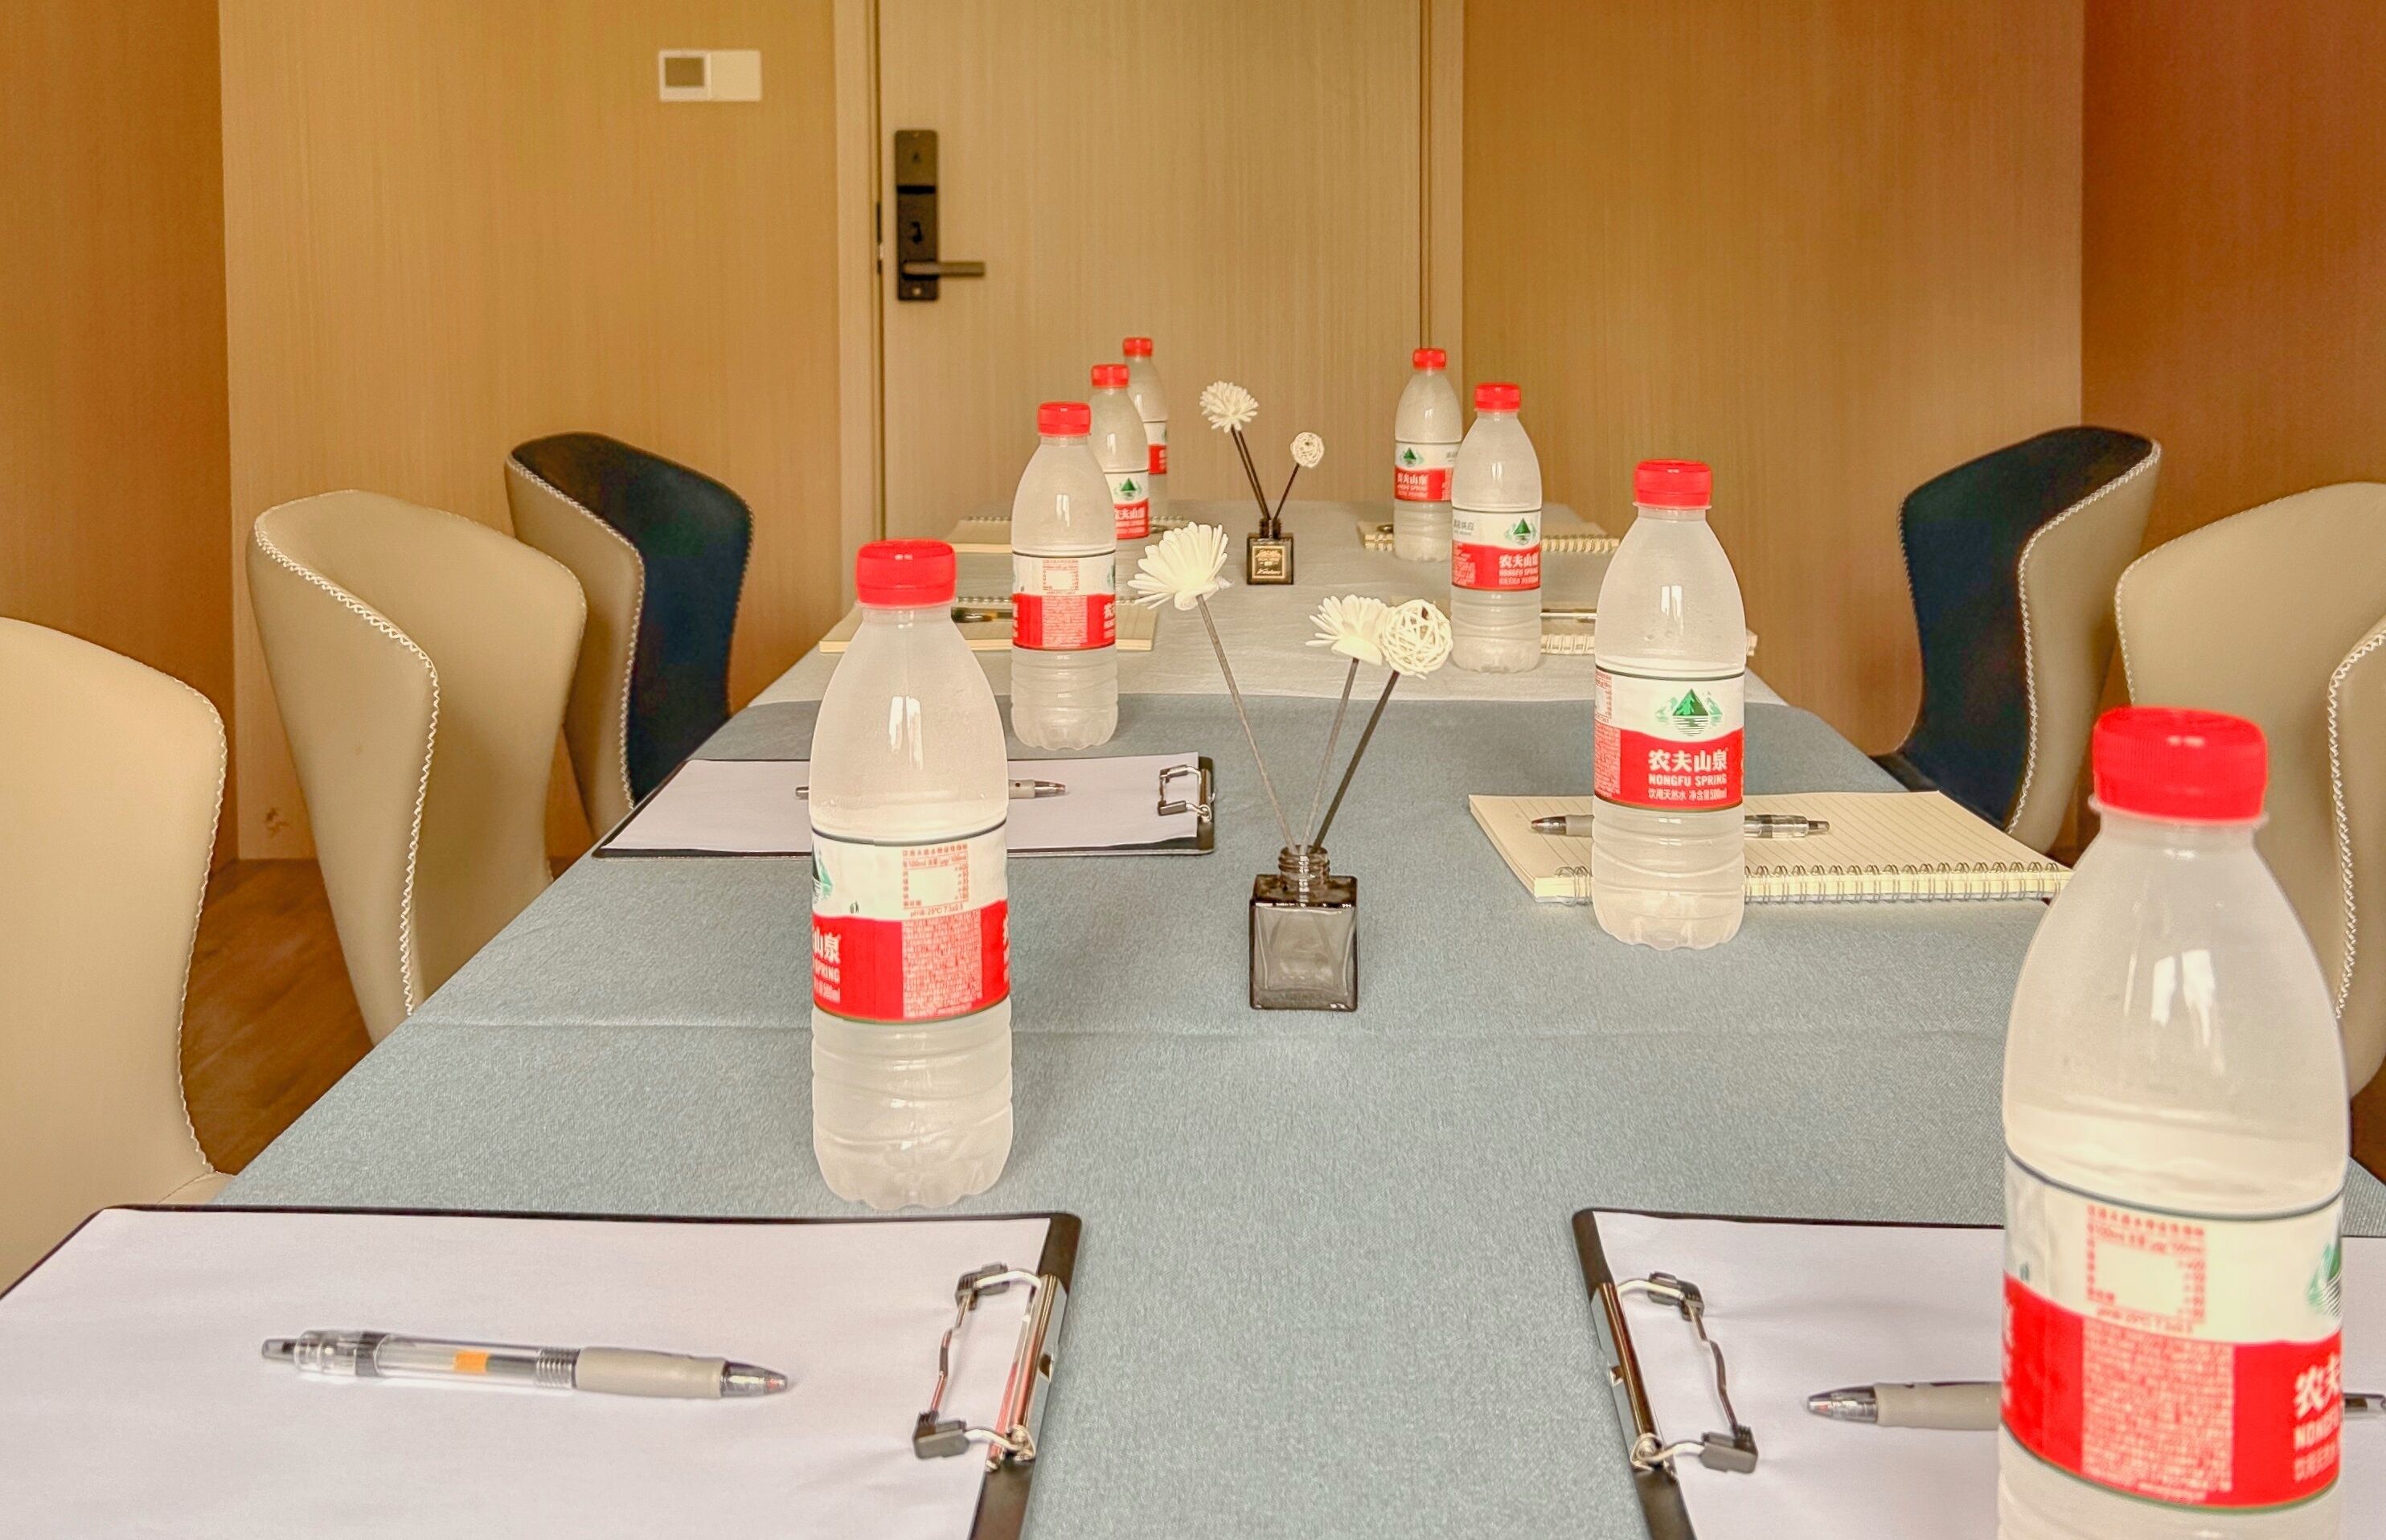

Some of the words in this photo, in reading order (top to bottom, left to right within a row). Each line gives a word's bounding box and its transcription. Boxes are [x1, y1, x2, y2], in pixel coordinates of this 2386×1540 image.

[1648, 748, 1728, 772] 农夫山泉
[1648, 773, 1692, 787] NONGFU
[1695, 772, 1728, 787] SPRING
[1648, 788, 1687, 801] 饮用天然水
